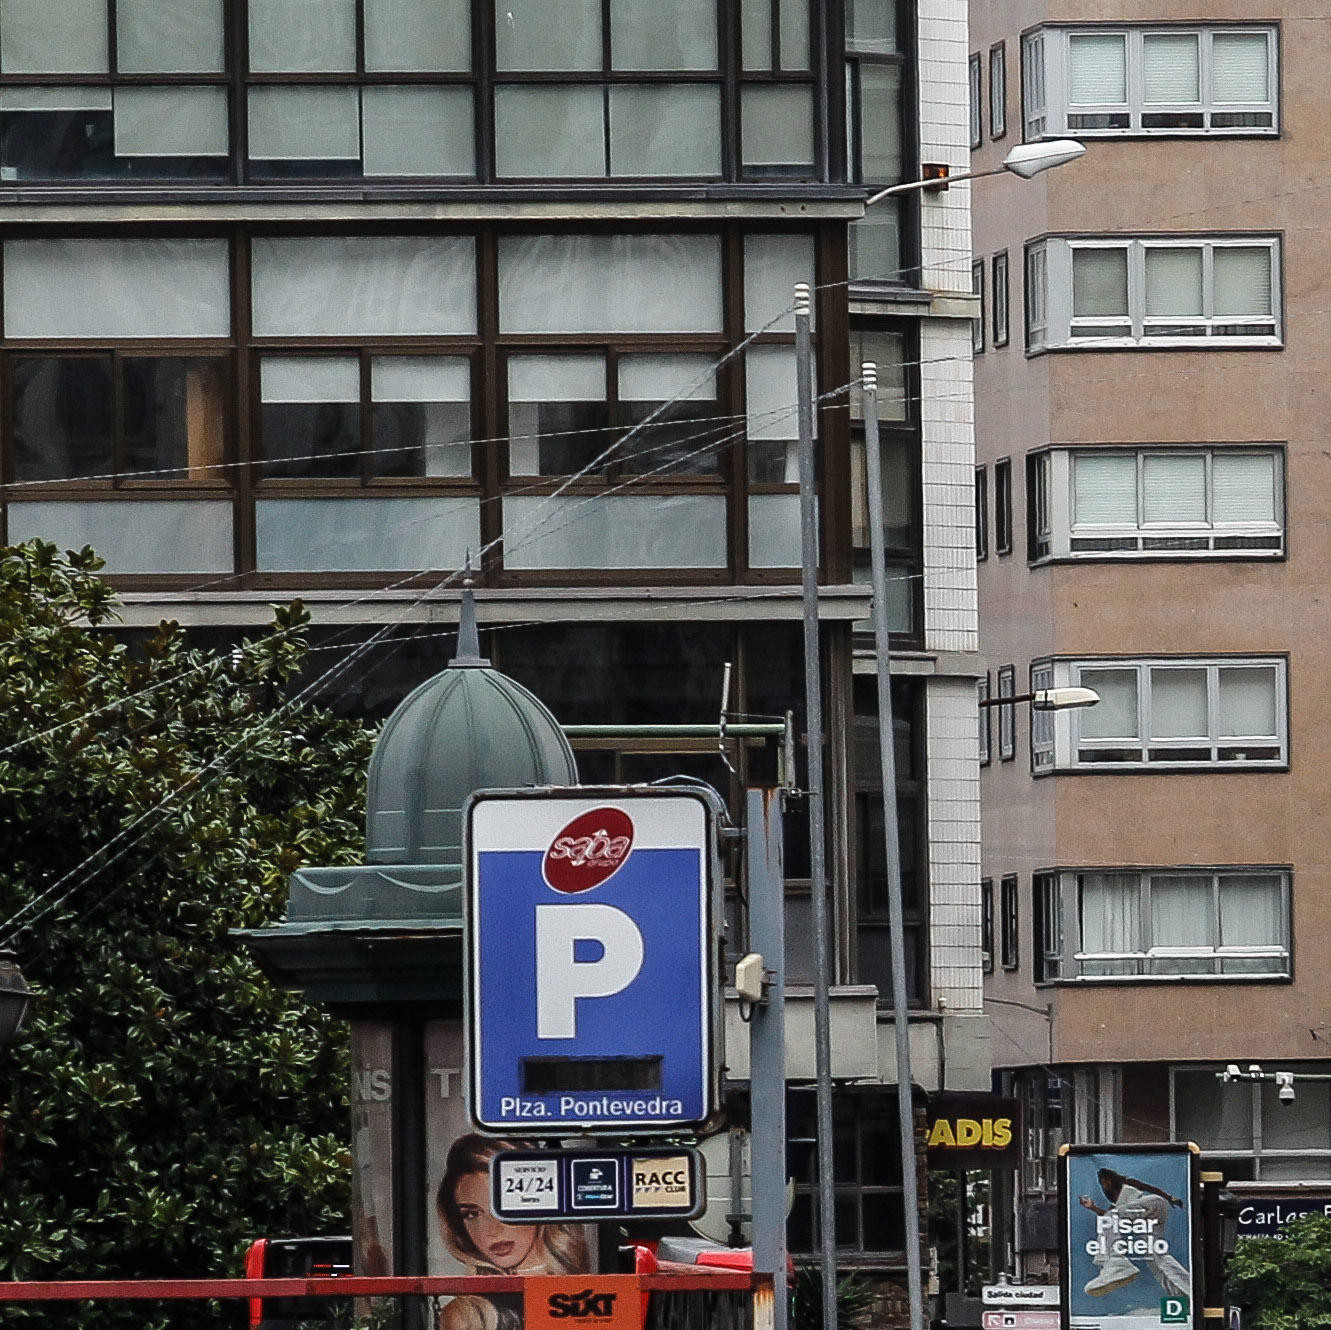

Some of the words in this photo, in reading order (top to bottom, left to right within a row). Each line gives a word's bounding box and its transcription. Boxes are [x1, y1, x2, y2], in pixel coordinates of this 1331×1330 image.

[536, 903, 644, 1039] P
[501, 1097, 552, 1117] Plza.
[560, 1097, 683, 1117] Pontevedra
[925, 1118, 1012, 1147] ADIS
[505, 1177, 554, 1194] 24/24
[635, 1171, 686, 1186] RACC
[665, 1185, 686, 1193] CLUB
[1096, 1214, 1159, 1234] Pisar
[1085, 1235, 1106, 1255] el
[1113, 1235, 1169, 1255] cielo
[548, 1289, 618, 1319] SIXT
[1165, 1300, 1183, 1316] D
